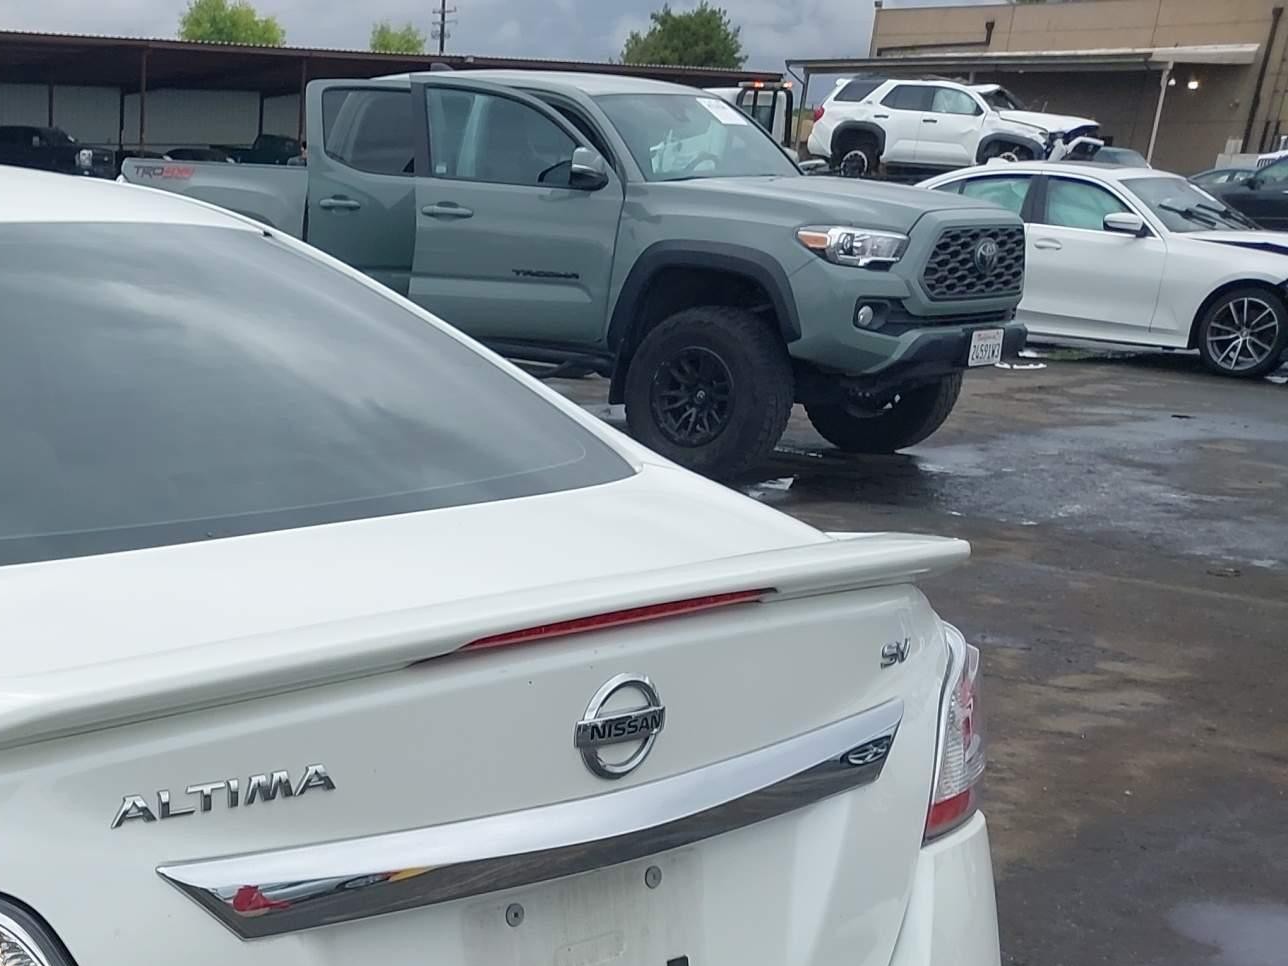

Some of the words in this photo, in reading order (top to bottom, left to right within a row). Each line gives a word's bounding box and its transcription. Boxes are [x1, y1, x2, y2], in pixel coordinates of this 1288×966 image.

[880, 637, 911, 669] SV
[590, 713, 662, 741] NISSAN
[110, 763, 337, 830] ALTIMA
